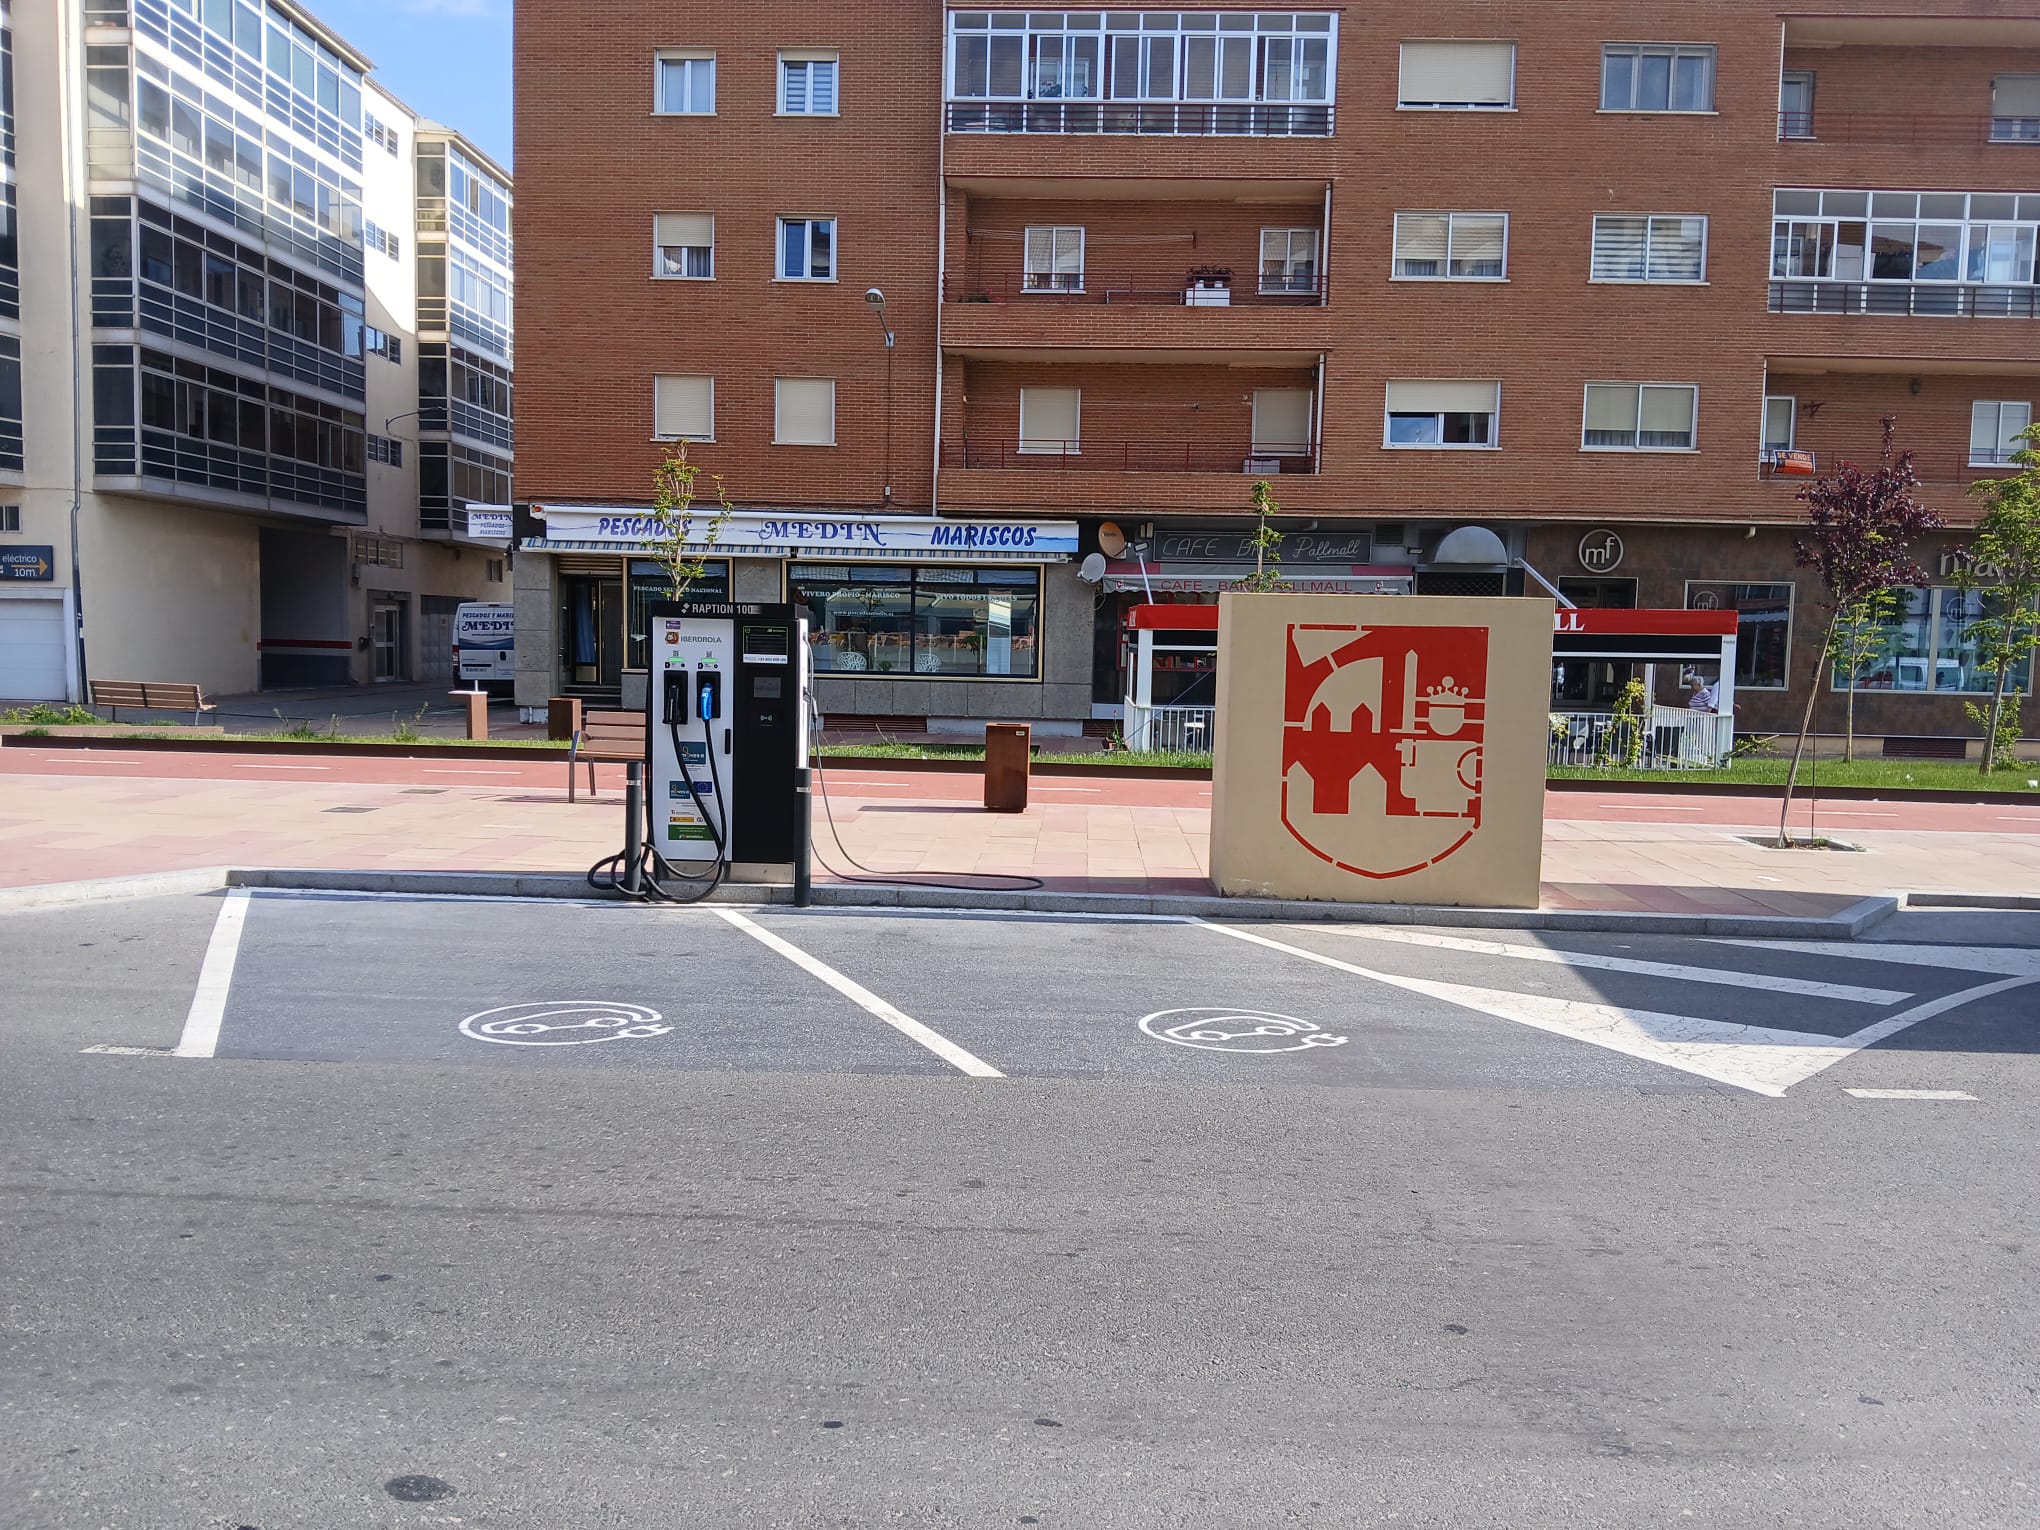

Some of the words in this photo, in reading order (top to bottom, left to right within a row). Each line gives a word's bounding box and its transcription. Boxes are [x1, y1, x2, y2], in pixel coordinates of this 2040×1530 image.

[1788, 453, 1812, 462] VENDE
[471, 513, 512, 522] MEDIN
[758, 521, 887, 546] MEDIN
[931, 525, 1038, 546] MARISCOS
[1161, 538, 1220, 557] CAFE
[1291, 536, 1359, 560] Pallmall
[1585, 536, 1615, 564] mf
[2, 554, 37, 563] eléctrico
[14, 568, 38, 577] 10m.
[1160, 580, 1203, 591] CAFE
[691, 603, 734, 614] RAPTION
[461, 621, 514, 632] MEDI
